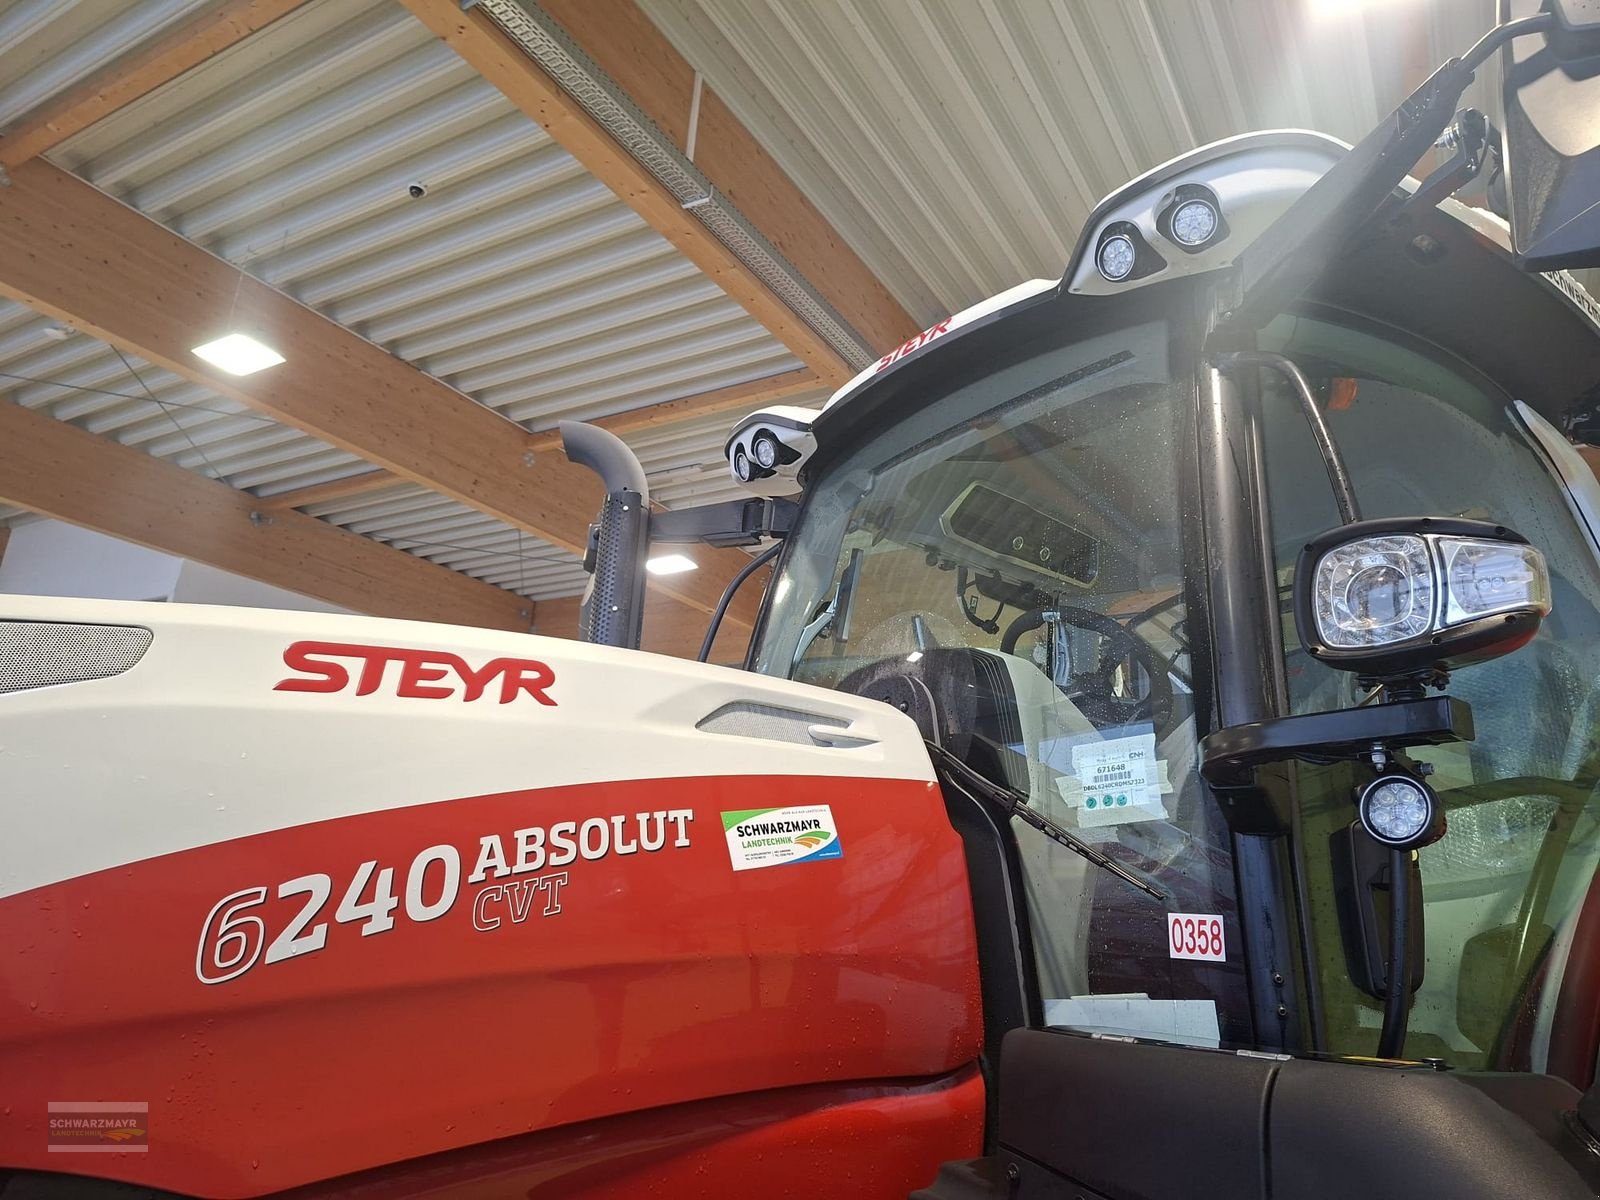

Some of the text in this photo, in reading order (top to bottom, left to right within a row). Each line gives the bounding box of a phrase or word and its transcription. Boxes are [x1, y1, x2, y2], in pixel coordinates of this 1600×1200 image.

[876, 315, 952, 372] STEYR
[272, 641, 558, 706] STEYR
[1097, 764, 1126, 774] 671648
[1129, 751, 1144, 759] CNH
[737, 819, 821, 838] SCHWARZMAYR
[742, 836, 793, 849] LANDTECHNIK
[195, 808, 694, 984] 6240 ABSOLUT
[472, 871, 568, 932] CVT
[1172, 918, 1222, 955] 0358
